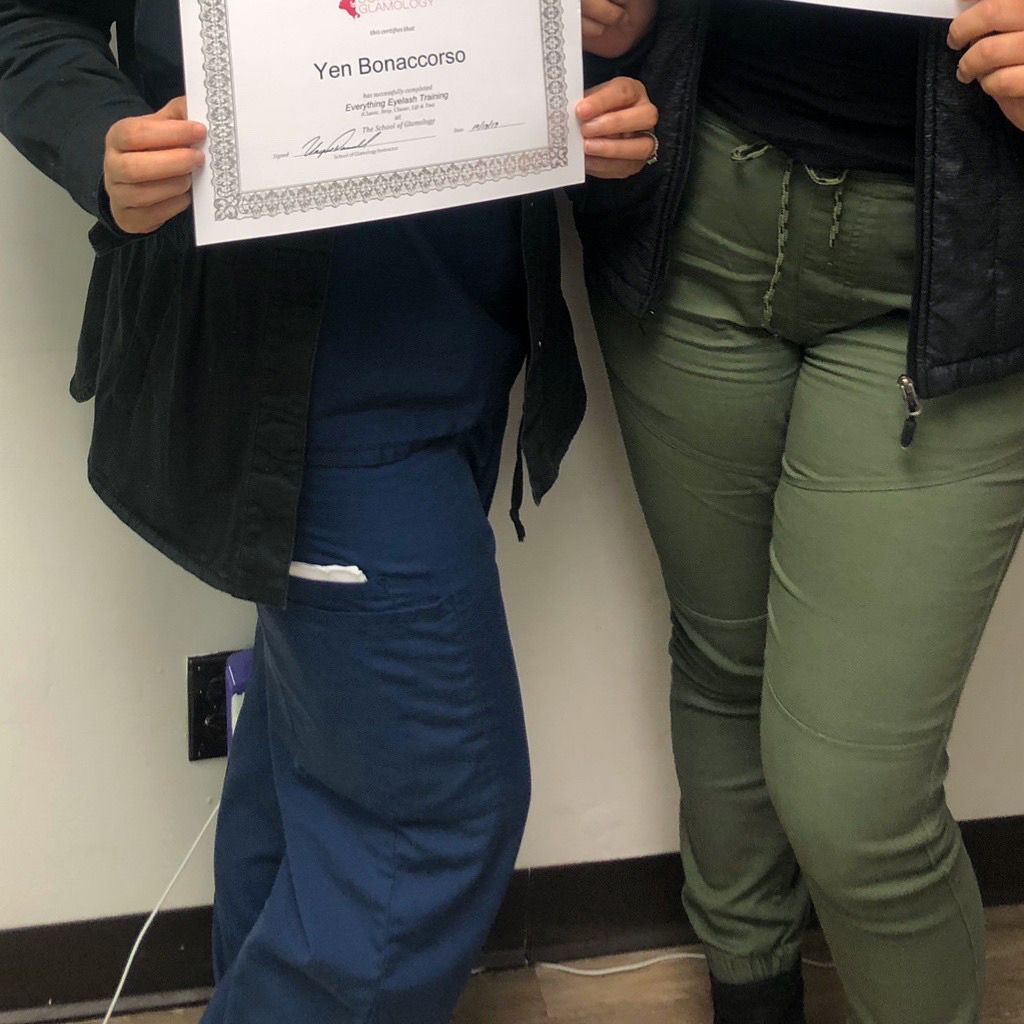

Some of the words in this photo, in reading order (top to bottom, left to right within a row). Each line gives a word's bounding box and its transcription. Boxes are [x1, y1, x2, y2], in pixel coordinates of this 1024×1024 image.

[313, 62, 352, 80] Yen
[358, 49, 466, 76] Bonaccorso
[344, 99, 386, 114] Everything
[387, 95, 419, 108] Eyelash
[419, 91, 450, 104] Training
[362, 125, 374, 134] The
[374, 122, 398, 133] School
[398, 120, 404, 131] of
[404, 116, 436, 128] Glamology
